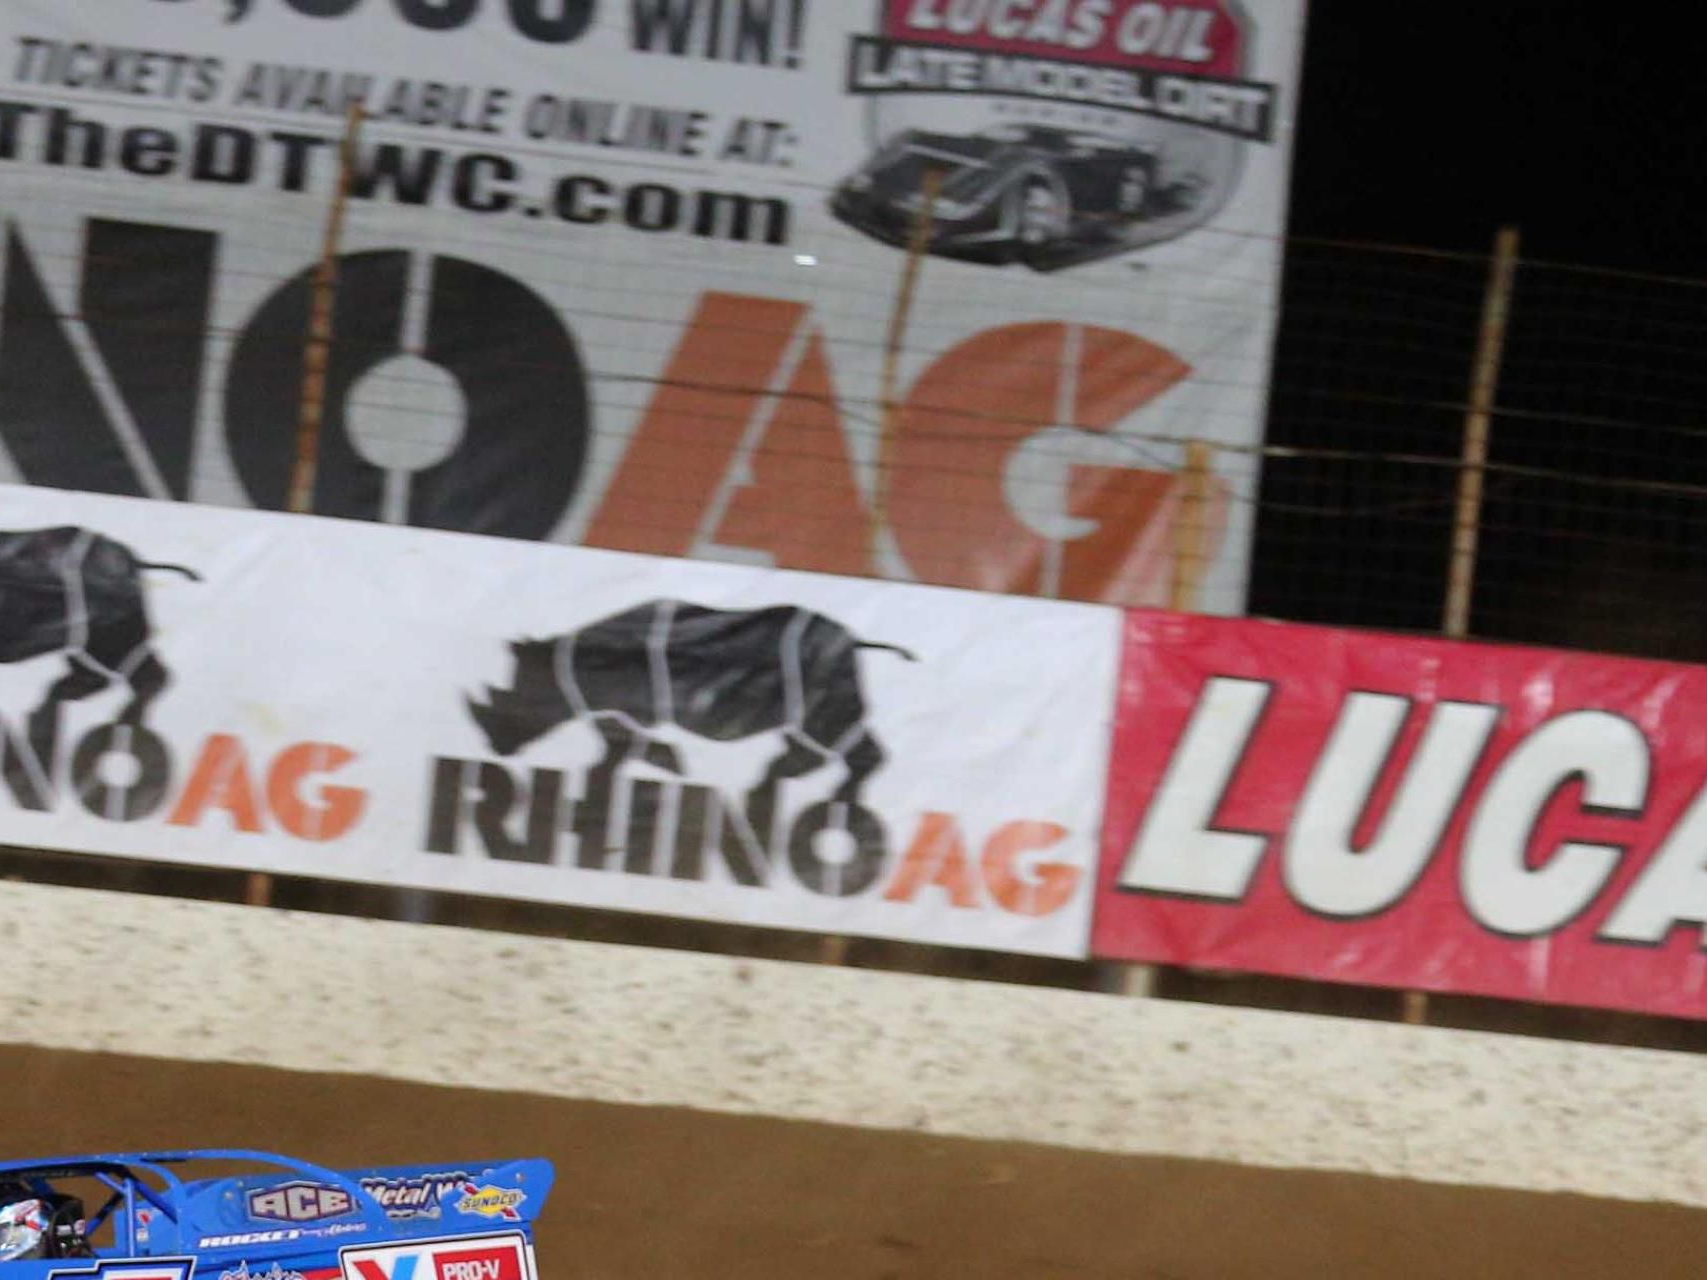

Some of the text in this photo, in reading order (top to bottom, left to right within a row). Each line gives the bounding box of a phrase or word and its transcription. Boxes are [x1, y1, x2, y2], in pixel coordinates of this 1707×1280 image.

[1116, 2, 1216, 63] OIL
[14, 37, 797, 168] TICKETS AVAILABLE ONLINE AT:
[854, 42, 982, 90] LATE
[984, 56, 1153, 108] MODEL
[1153, 72, 1268, 134] DIRT
[251, 1186, 349, 1222] ACE
[459, 1192, 522, 1211] SUNOCO
